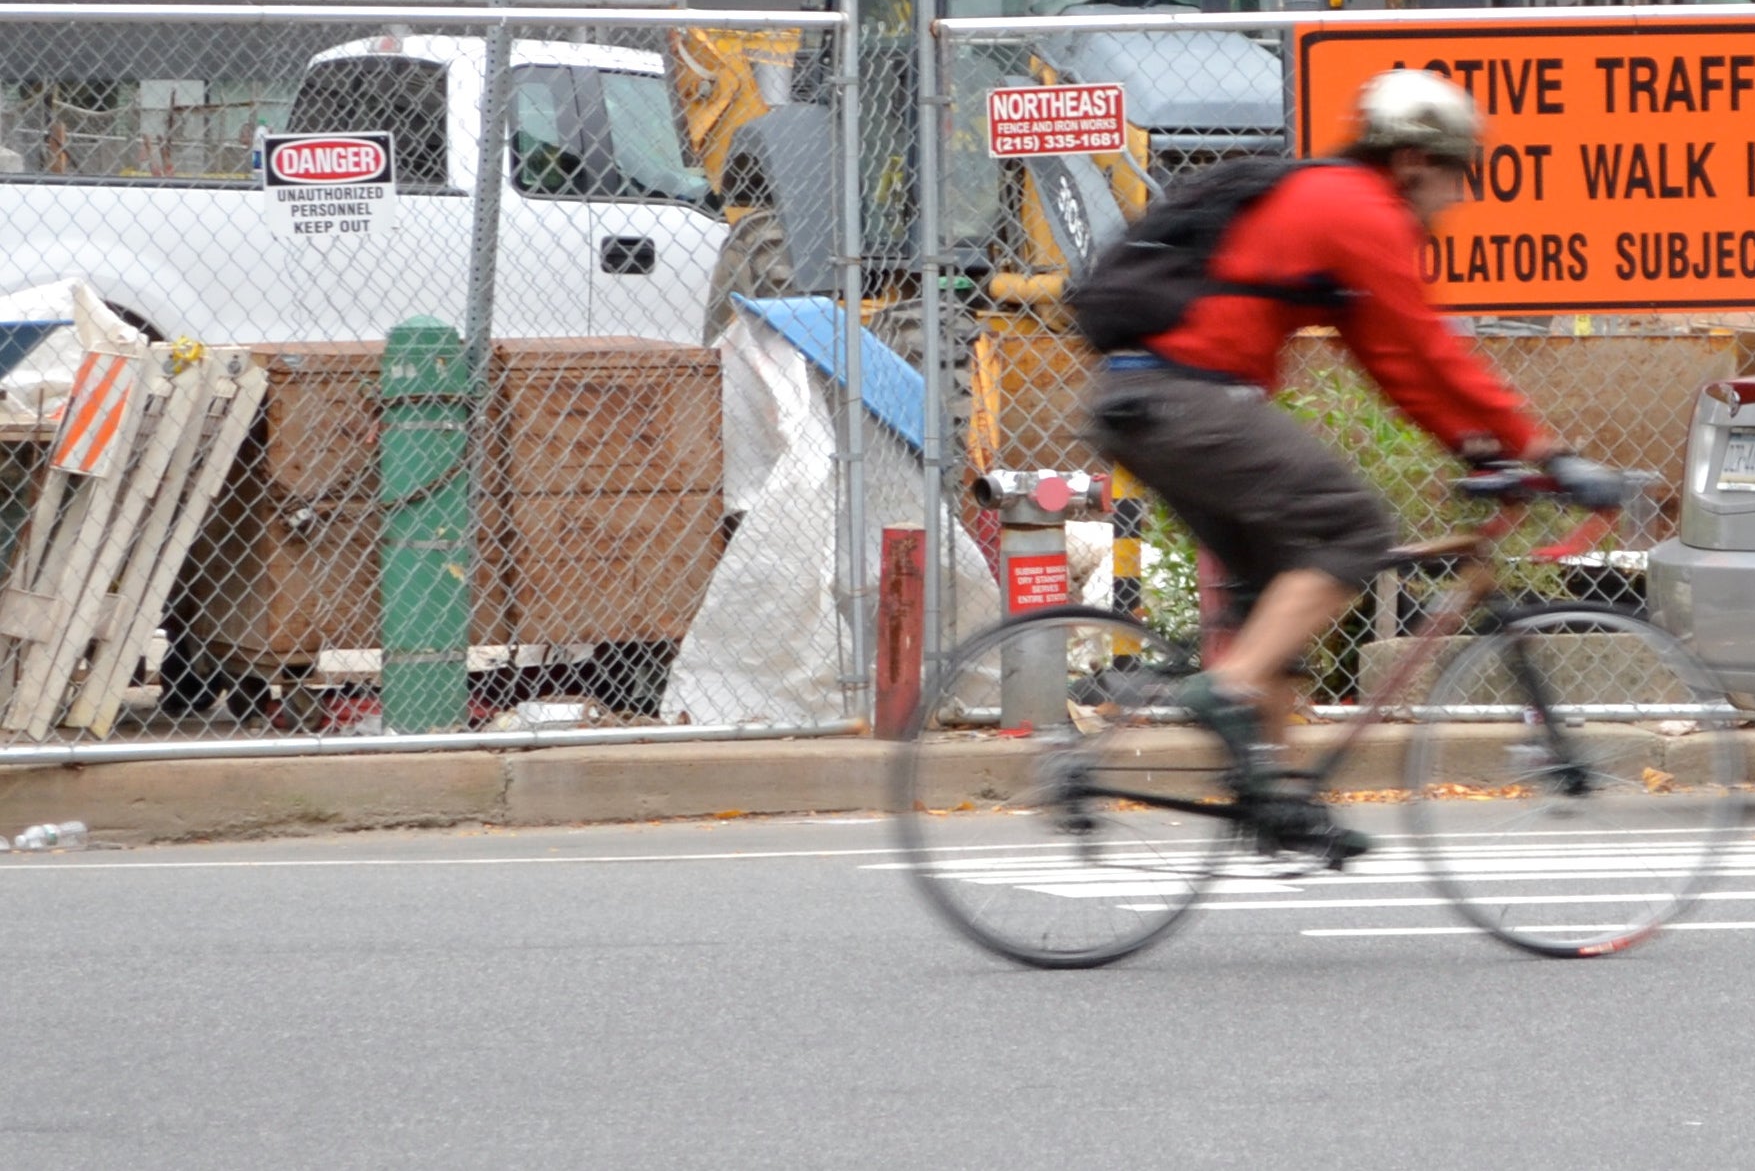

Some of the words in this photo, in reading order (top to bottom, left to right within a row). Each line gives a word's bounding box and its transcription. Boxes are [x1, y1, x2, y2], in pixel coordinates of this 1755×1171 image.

[1393, 57, 1564, 116] TIVE
[993, 90, 1119, 120] NORTHEAST
[998, 121, 1030, 134] FENCE
[1032, 120, 1052, 133] AND
[1054, 119, 1078, 132] IRON
[1080, 118, 1117, 130] WORKS
[996, 135, 1040, 151] (215)
[1044, 132, 1120, 148] 335-1681
[282, 146, 376, 174] DANGER
[1580, 142, 1717, 199] WALK
[277, 187, 384, 202] UNAUTHORIZED
[291, 203, 372, 217] PERSONNEL
[294, 221, 334, 234] KEEP
[340, 220, 370, 232] OUT
[1419, 233, 1588, 284] OLATORS
